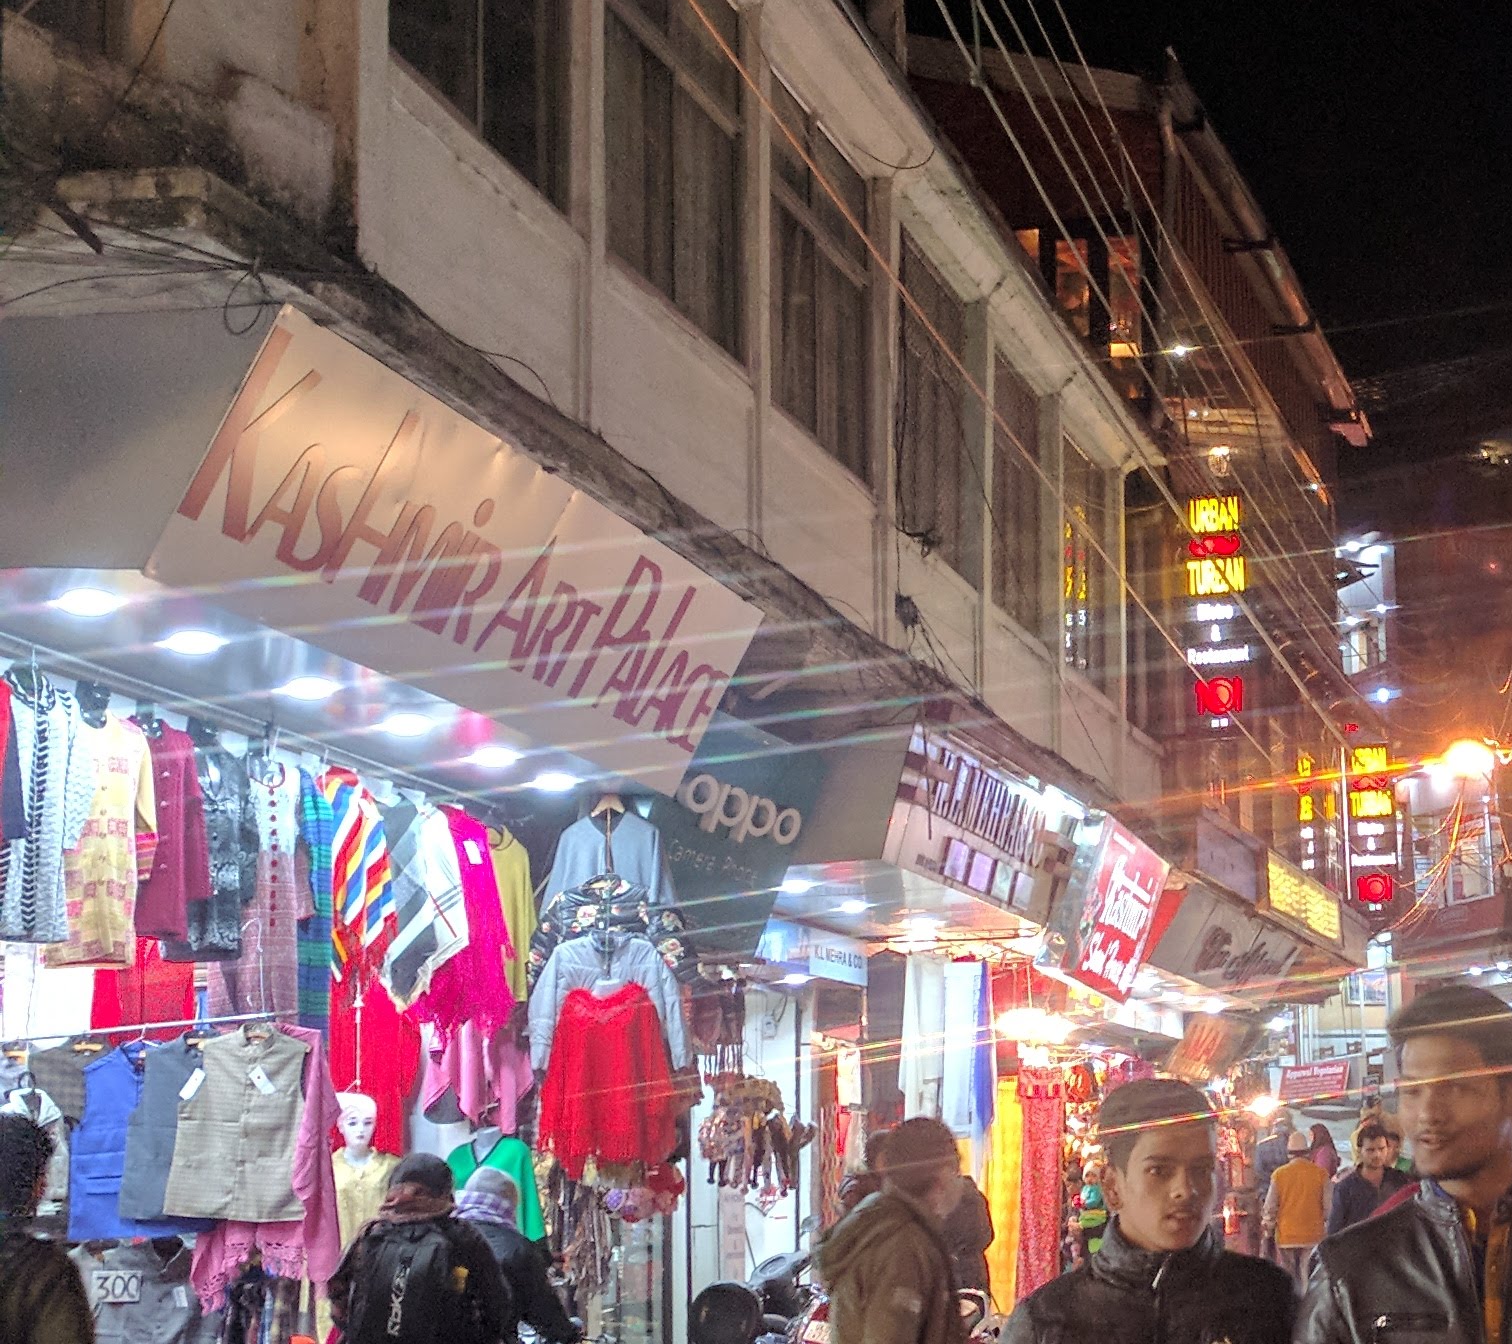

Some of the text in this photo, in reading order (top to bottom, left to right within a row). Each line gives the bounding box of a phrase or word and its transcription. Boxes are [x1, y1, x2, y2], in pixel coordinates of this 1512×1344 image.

[1189, 496, 1239, 533] URBAN
[475, 535, 602, 698] ART
[676, 774, 801, 845] oppo
[97, 1274, 139, 1300] 300
